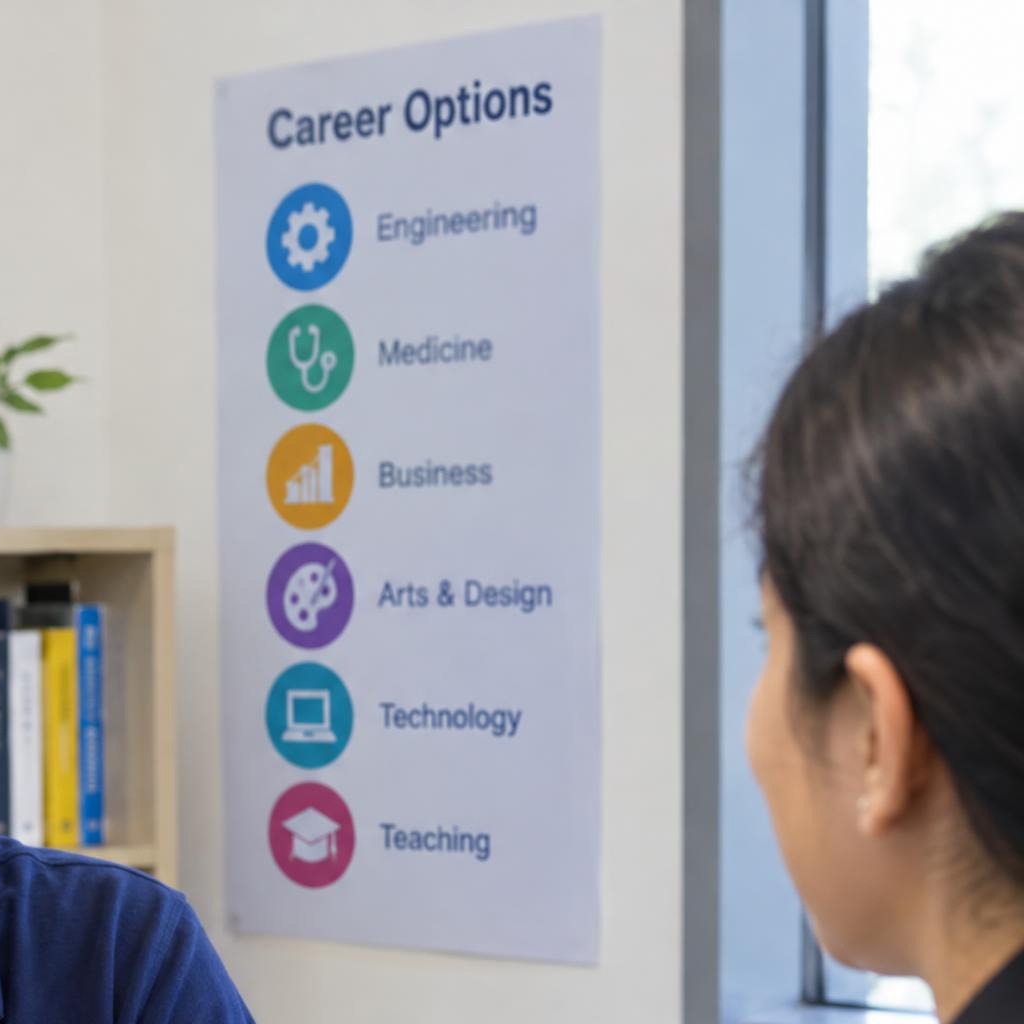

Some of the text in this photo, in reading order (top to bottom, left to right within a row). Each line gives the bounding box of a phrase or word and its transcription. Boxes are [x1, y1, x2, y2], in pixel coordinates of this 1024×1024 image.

[267, 80, 553, 149] Career Options
[377, 201, 538, 245] Engineering
[378, 334, 493, 366] Medicine
[378, 458, 493, 489] Business
[378, 579, 553, 614] Arts & Design
[379, 702, 523, 738] Technology
[380, 822, 491, 862] Teaching
